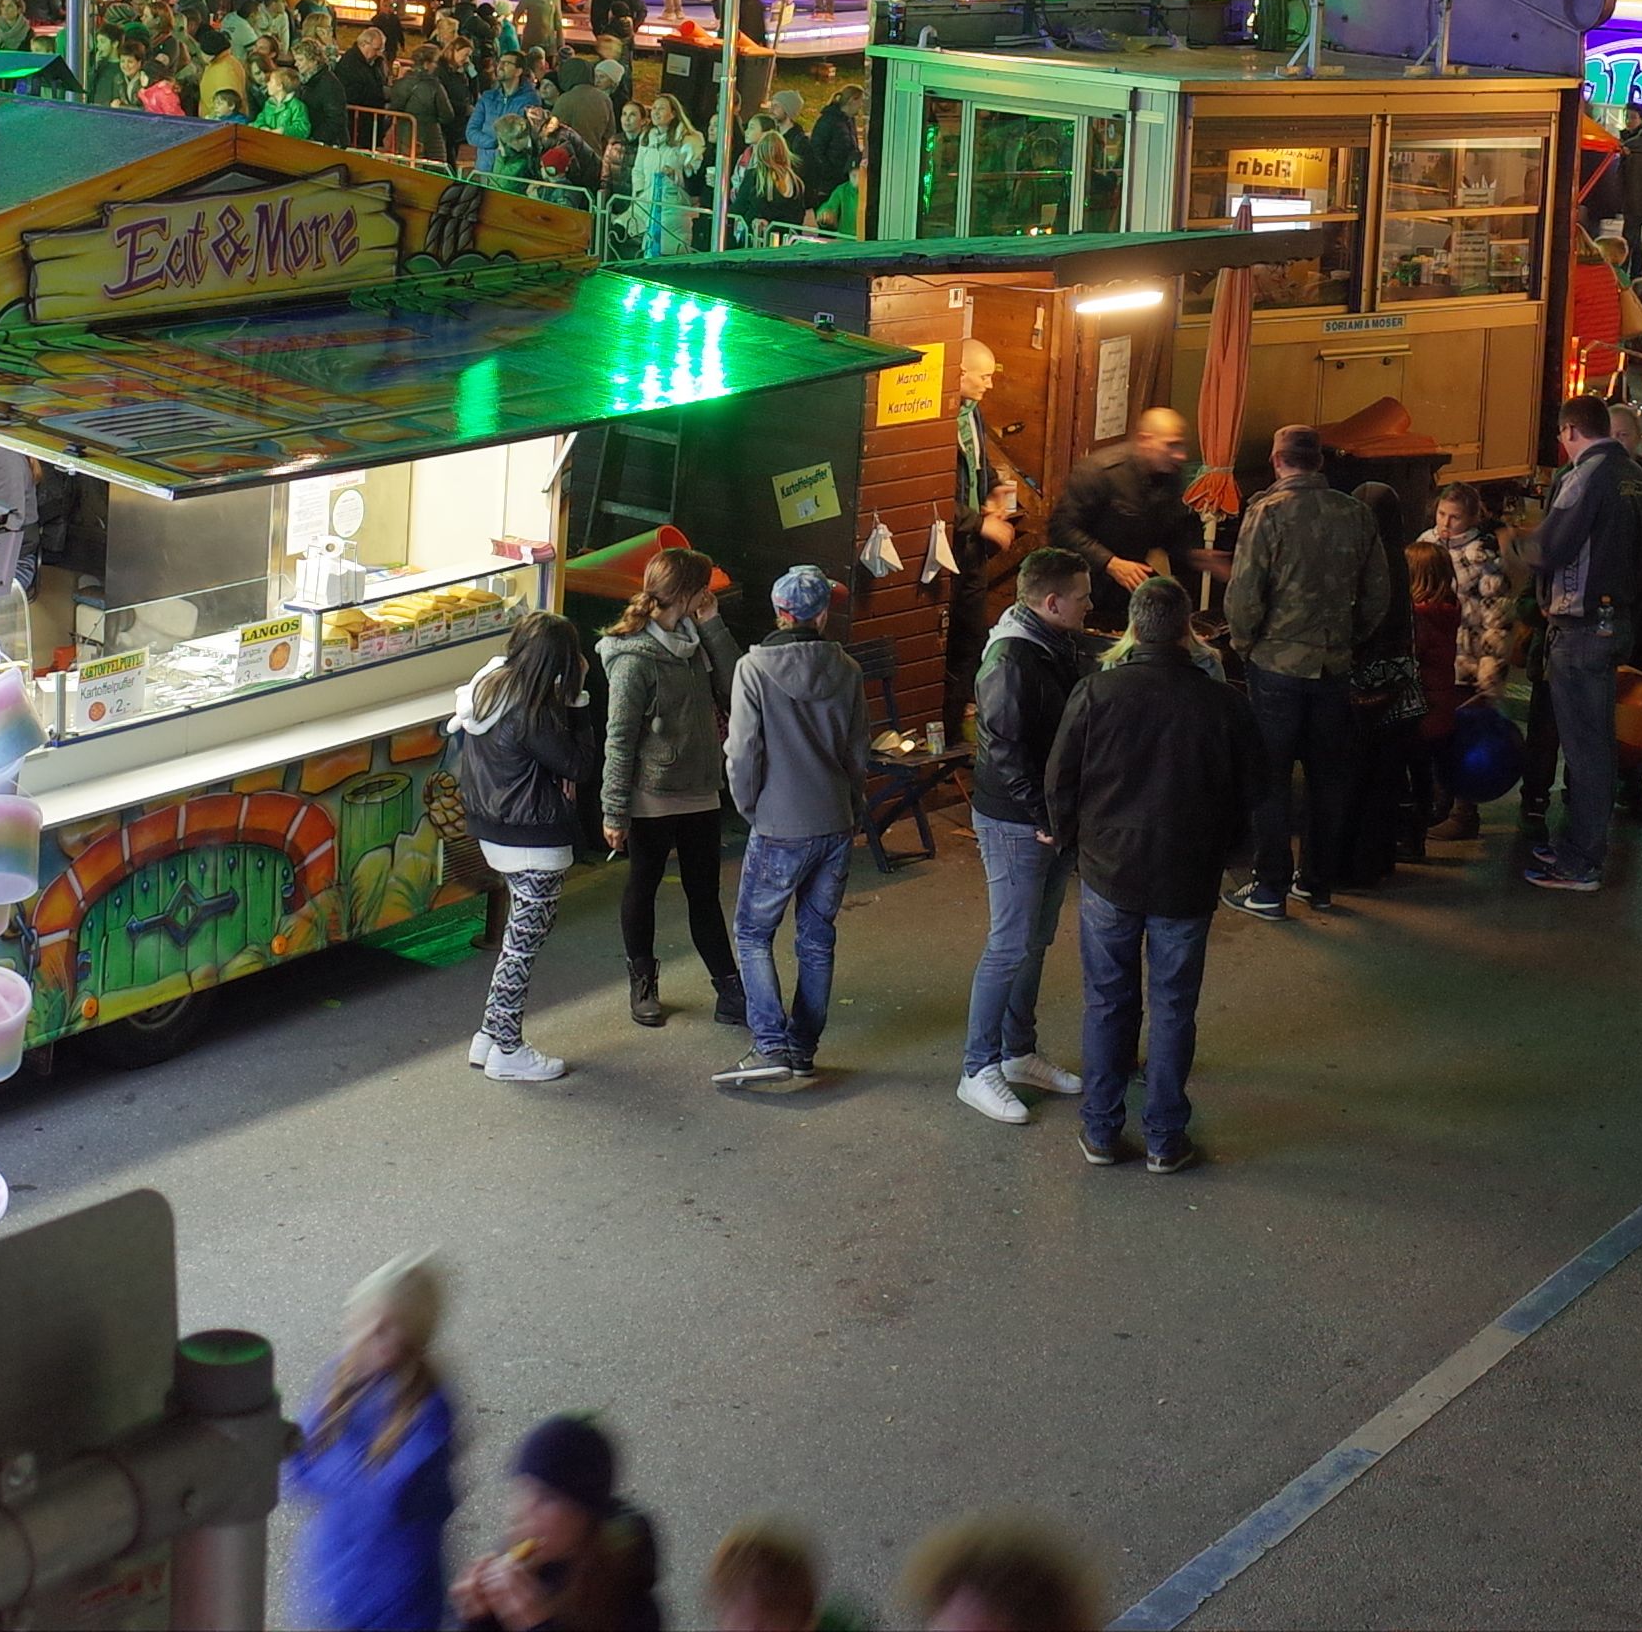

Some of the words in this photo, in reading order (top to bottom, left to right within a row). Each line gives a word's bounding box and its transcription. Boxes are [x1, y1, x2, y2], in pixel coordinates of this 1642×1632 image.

[102, 210, 208, 300] Eat
[210, 203, 252, 278] &
[247, 195, 360, 285] More
[1372, 316, 1403, 328] MOSER
[896, 370, 928, 385] Maroni
[888, 398, 933, 415] Kartoffeln
[241, 619, 300, 643] LANGOS
